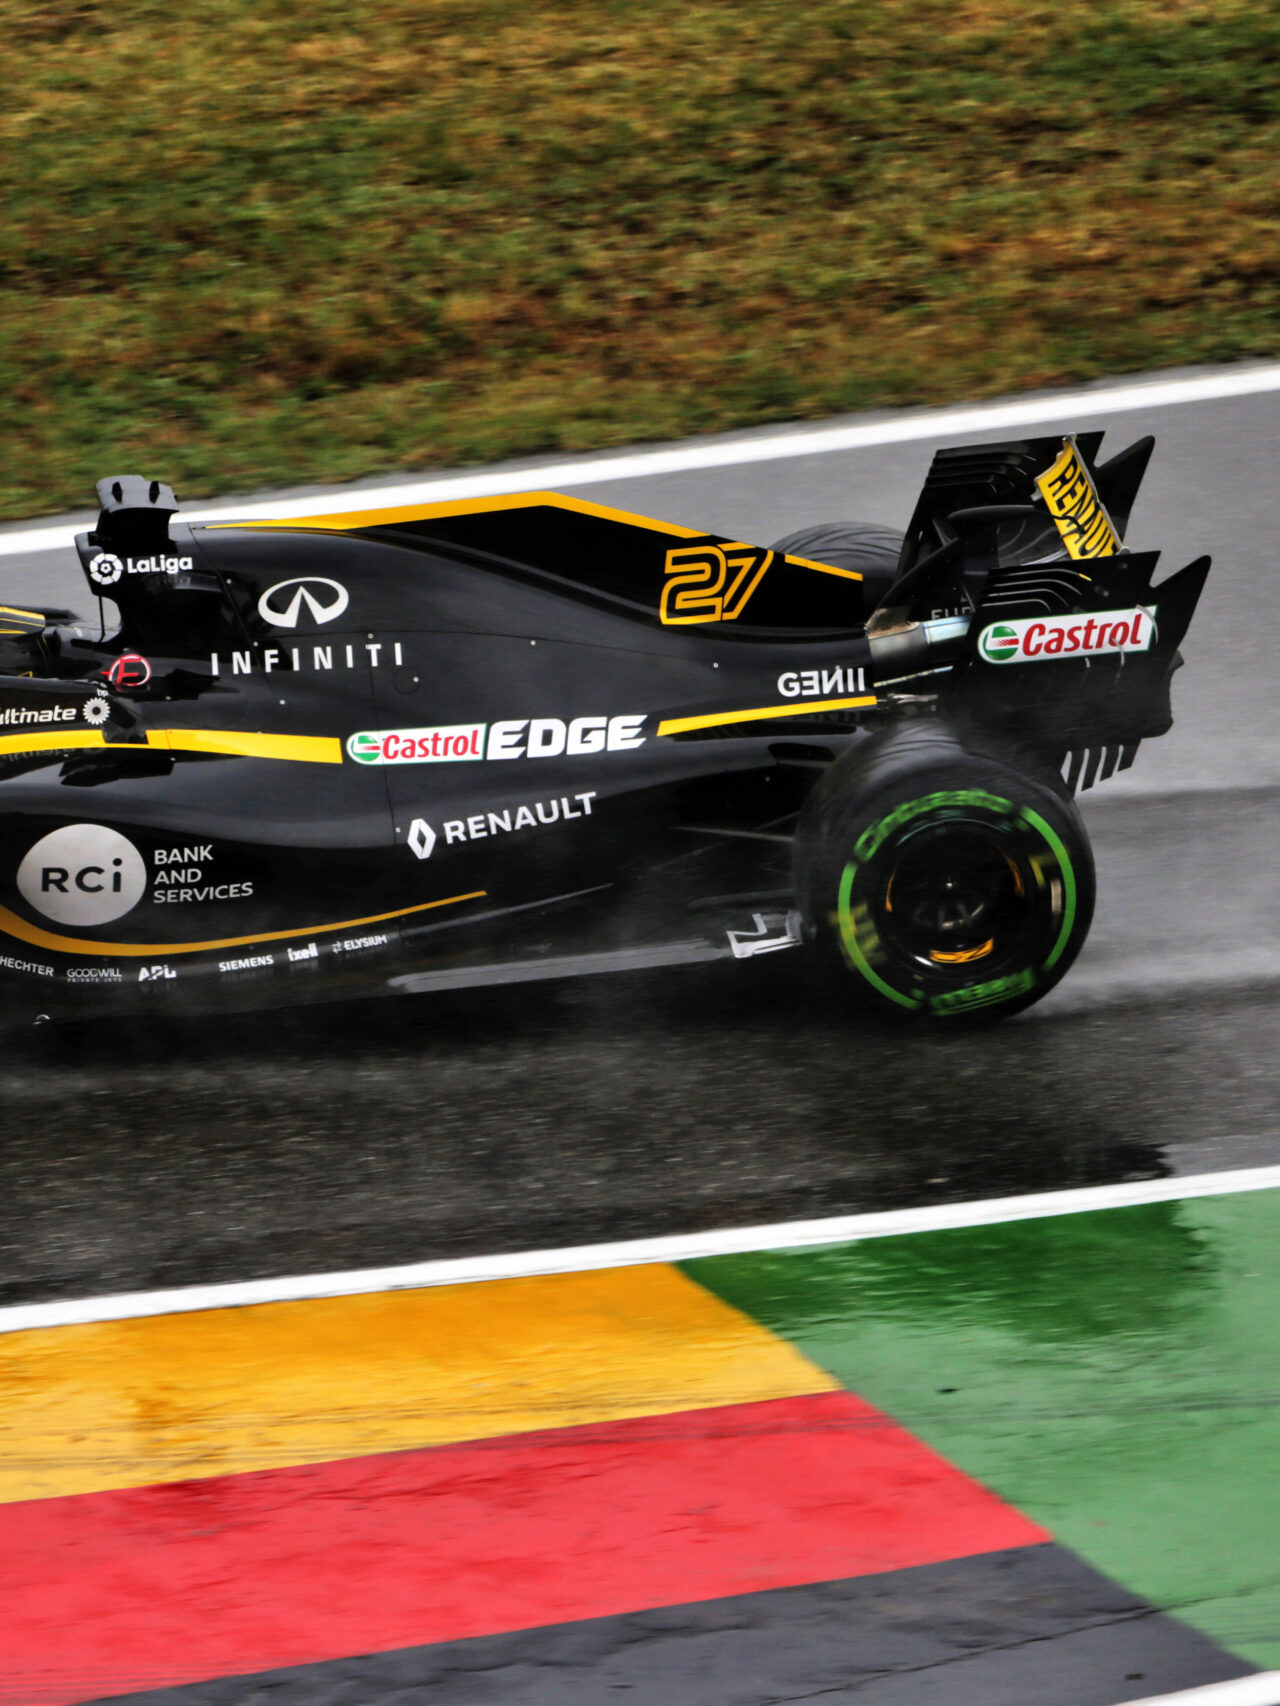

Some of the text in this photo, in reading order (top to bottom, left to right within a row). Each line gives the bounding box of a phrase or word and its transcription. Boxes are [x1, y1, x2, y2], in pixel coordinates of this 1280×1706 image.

[1048, 454, 1118, 557] RENAU
[127, 554, 193, 575] LaLiga
[659, 544, 774, 625] 27
[1022, 614, 1142, 657] Castrol
[211, 642, 403, 676] INFINITI
[96, 688, 109, 697] bp
[381, 715, 648, 760] Castrol EDGE
[443, 791, 597, 845] RENAULT
[154, 844, 214, 865] BANK
[154, 867, 202, 885] AND
[153, 881, 254, 904] SERVICES
[287, 943, 318, 962] ixell
[344, 934, 387, 951] ELYSIUM
[0, 955, 54, 977] HECHTER
[66, 967, 122, 978] GOODWILL
[138, 965, 177, 982] APL
[219, 955, 274, 972] SIEMENS
